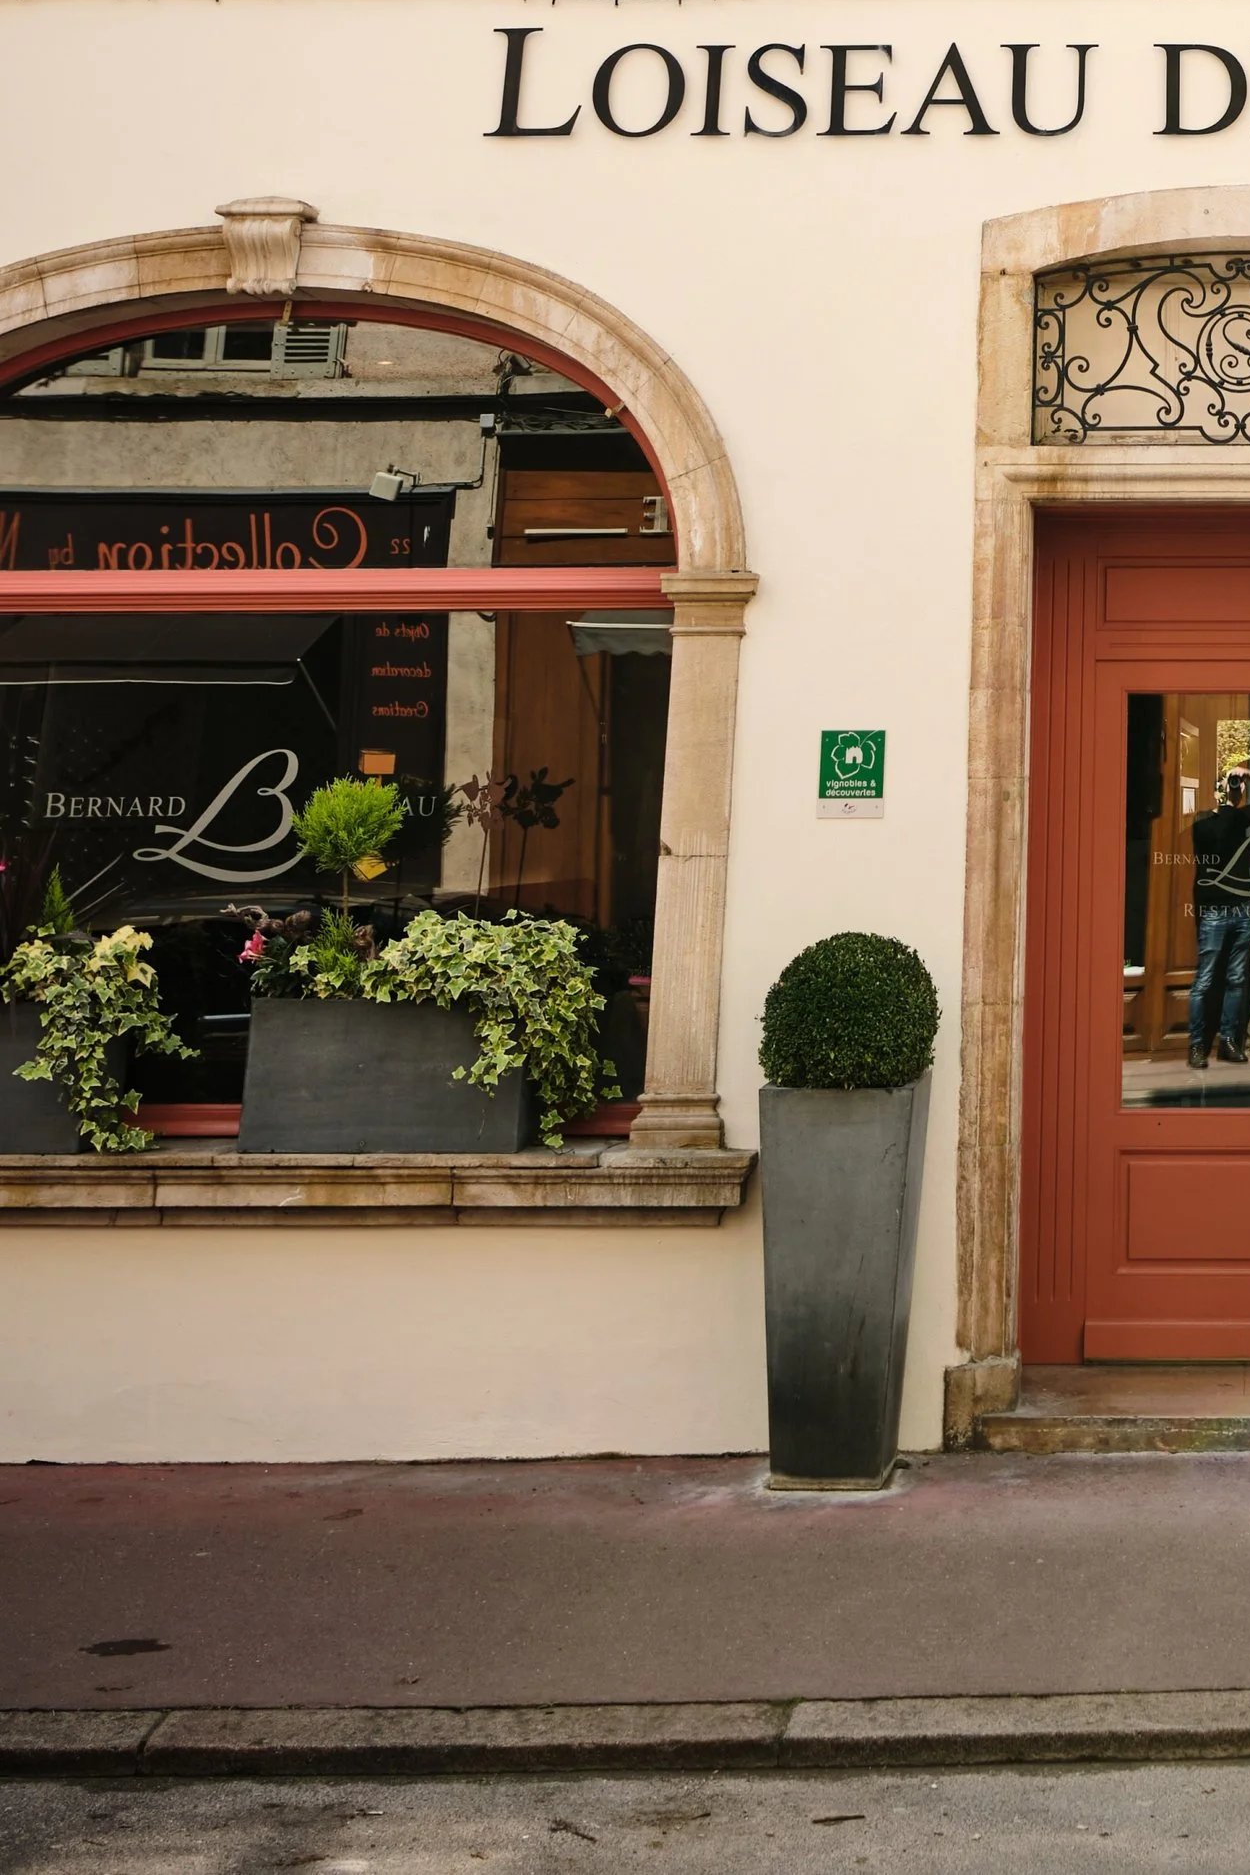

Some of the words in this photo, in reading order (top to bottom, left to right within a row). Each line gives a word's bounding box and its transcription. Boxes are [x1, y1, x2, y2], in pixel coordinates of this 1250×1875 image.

[482, 27, 1099, 138] LOISEAU
[826, 779, 867, 789] vignobles
[44, 792, 186, 818] BERNARD
[1153, 852, 1221, 865] BERNARD
